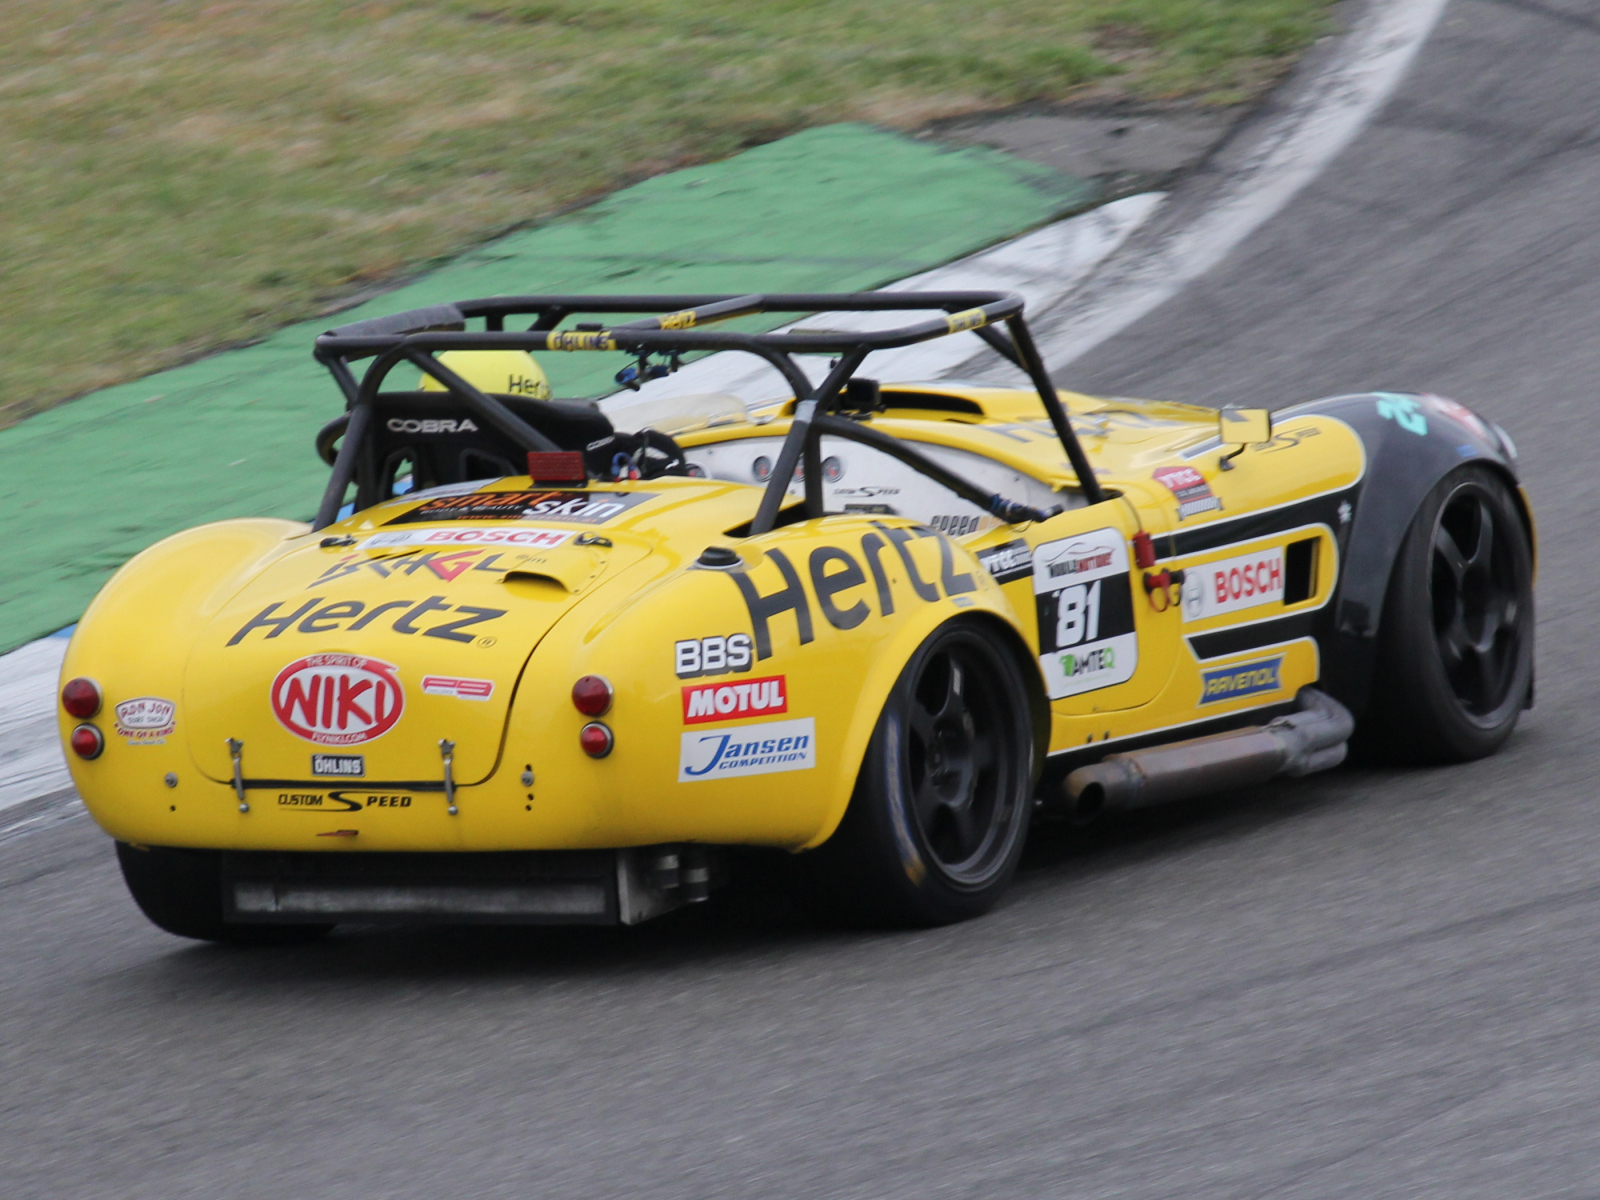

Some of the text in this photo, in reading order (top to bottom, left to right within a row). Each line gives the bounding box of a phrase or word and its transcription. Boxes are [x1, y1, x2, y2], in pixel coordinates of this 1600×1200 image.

[387, 418, 479, 433] COBRA
[419, 491, 562, 512] smart
[523, 498, 625, 518] skin
[424, 530, 565, 545] BOSCH
[725, 520, 977, 662] Hertz
[1215, 558, 1283, 604] BOSCH
[226, 596, 508, 647] Hertz
[675, 633, 753, 679] BBS
[1205, 667, 1276, 696] RAVENOL
[148, 703, 171, 715] JON
[281, 674, 386, 730] NIKI
[687, 680, 784, 718] MOTUL
[315, 755, 361, 774] ÖHLINS
[684, 734, 809, 776] Jansen
[718, 752, 807, 770] COMPETITION
[278, 790, 412, 812] CUSTOM SPEED
